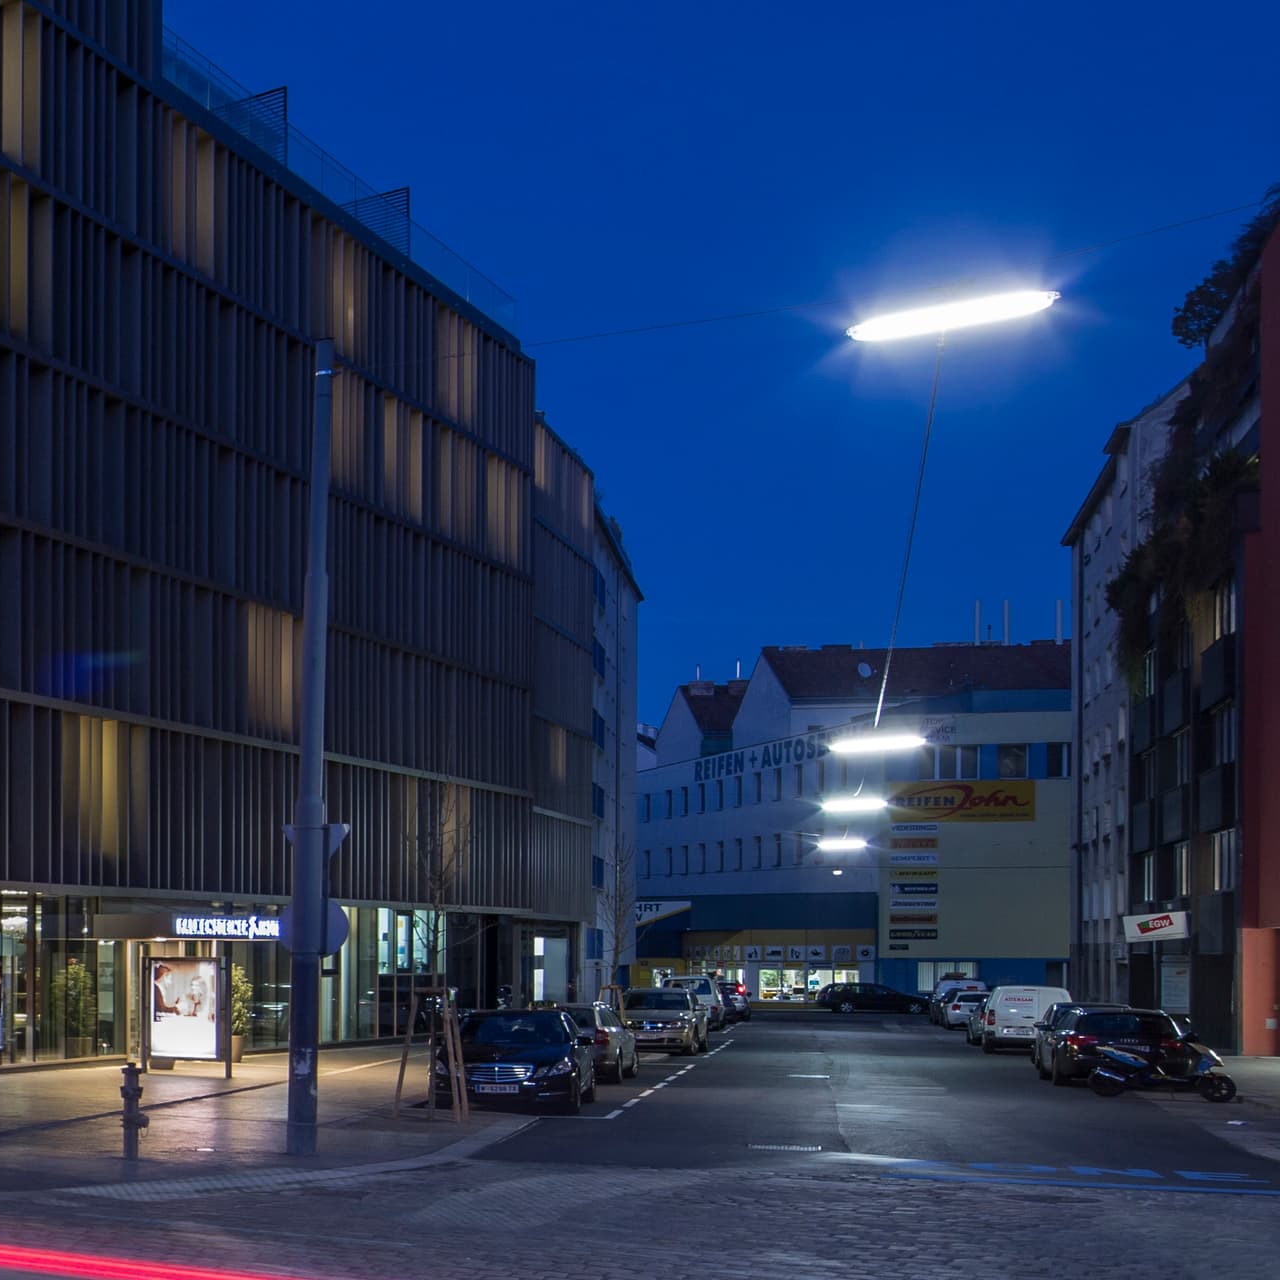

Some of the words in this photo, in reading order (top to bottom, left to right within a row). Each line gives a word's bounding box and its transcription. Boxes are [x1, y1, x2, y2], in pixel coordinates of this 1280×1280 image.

[694, 750, 744, 782] REIFEN
[896, 796, 955, 807] REIFEN
[956, 783, 1030, 812] John
[1148, 918, 1170, 929] EGW
